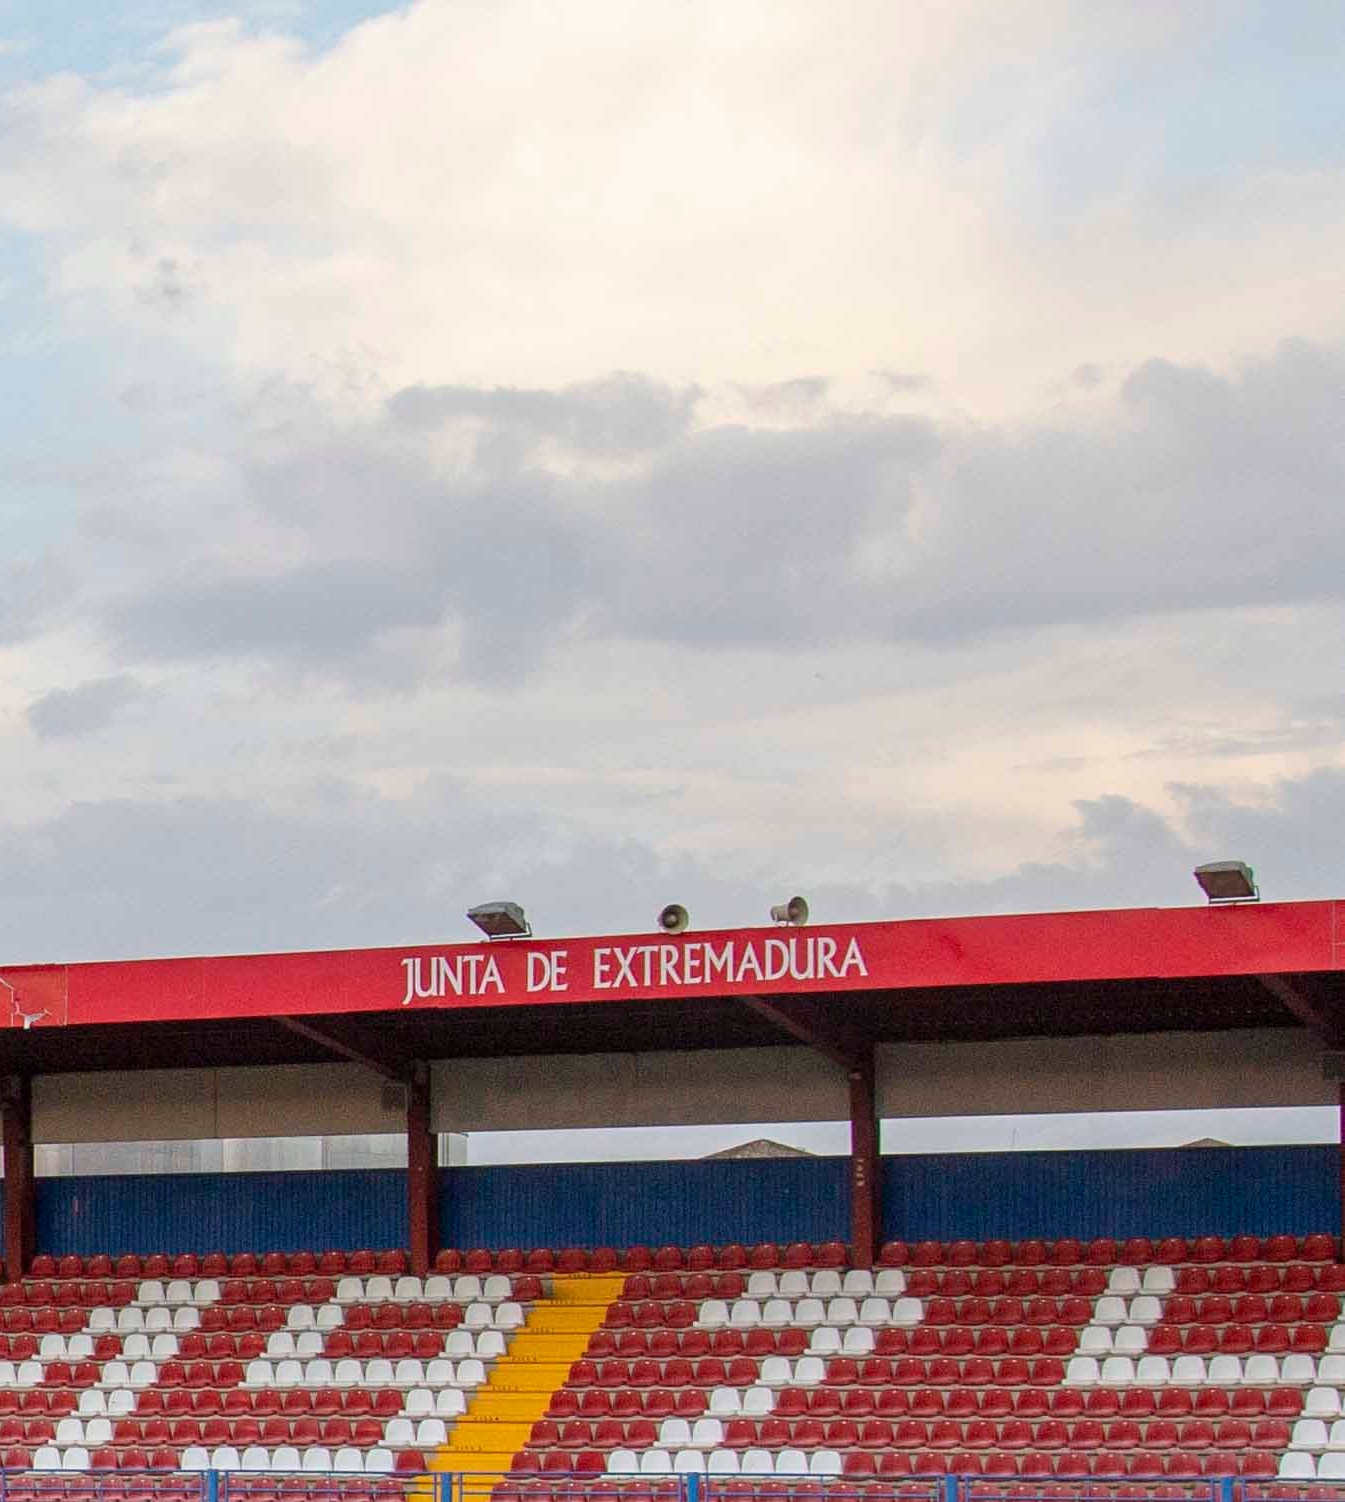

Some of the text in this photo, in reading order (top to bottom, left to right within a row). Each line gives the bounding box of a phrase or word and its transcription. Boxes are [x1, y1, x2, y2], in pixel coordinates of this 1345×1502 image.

[401, 937, 869, 1005] JUNTA DE EXTREMADURA
